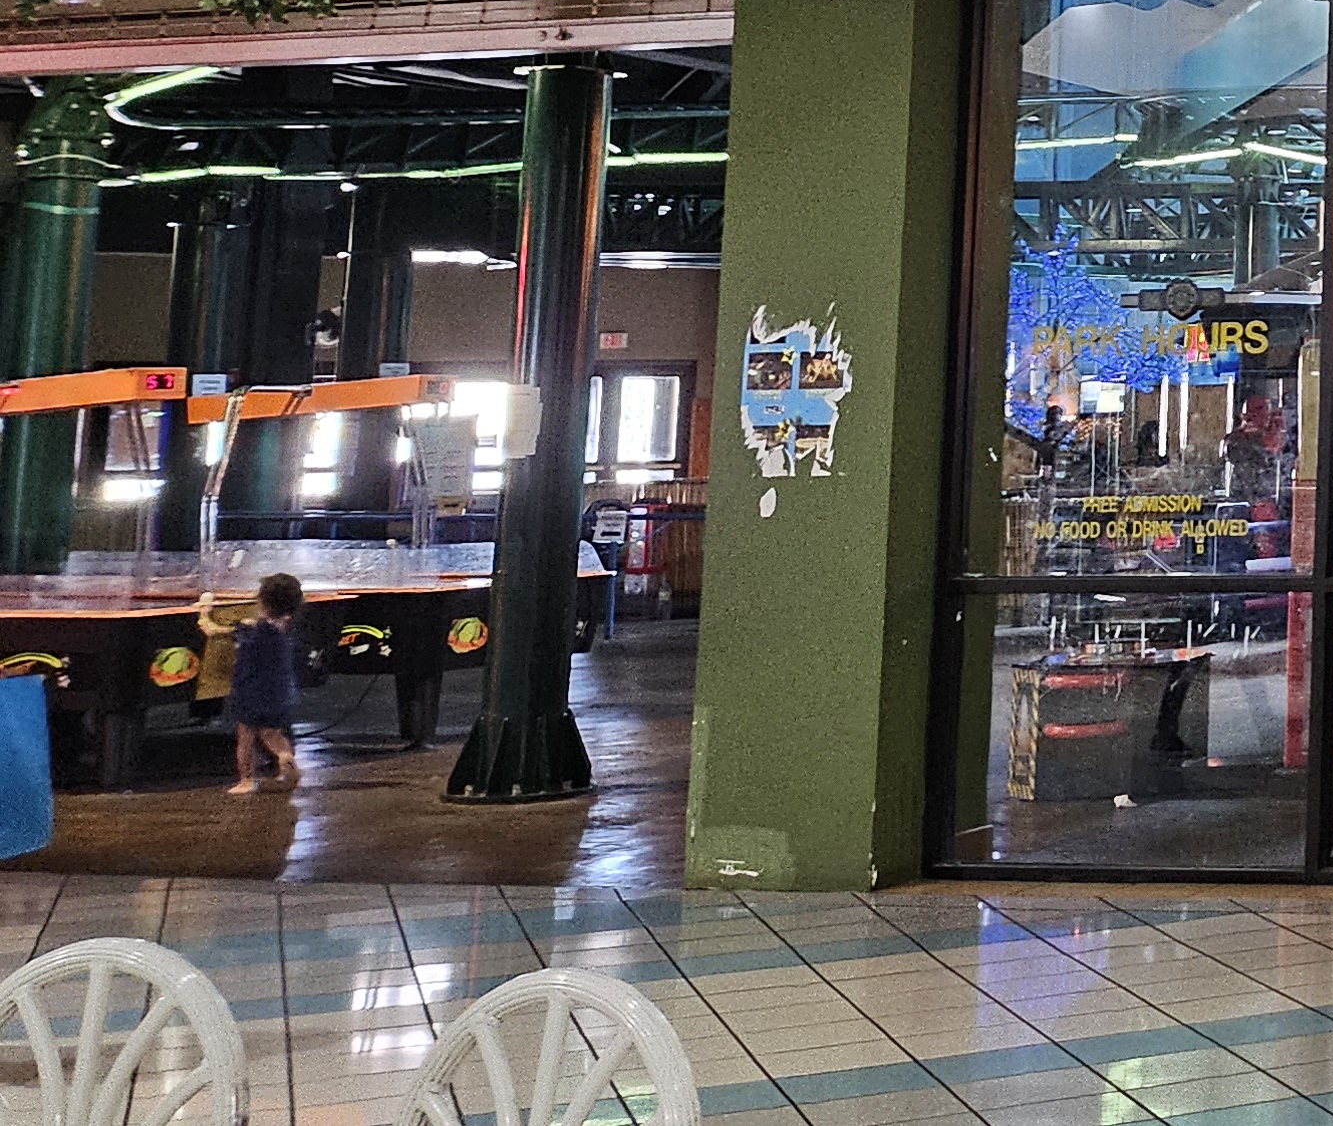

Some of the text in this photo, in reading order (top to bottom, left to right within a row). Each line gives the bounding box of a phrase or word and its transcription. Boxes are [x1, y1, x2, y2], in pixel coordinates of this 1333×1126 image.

[1032, 320, 1268, 355] PARK HOURS
[1083, 494, 1203, 513] FREE ADMISSION
[1034, 519, 1249, 539] NO FOOD OR DRINK ALLOWED
